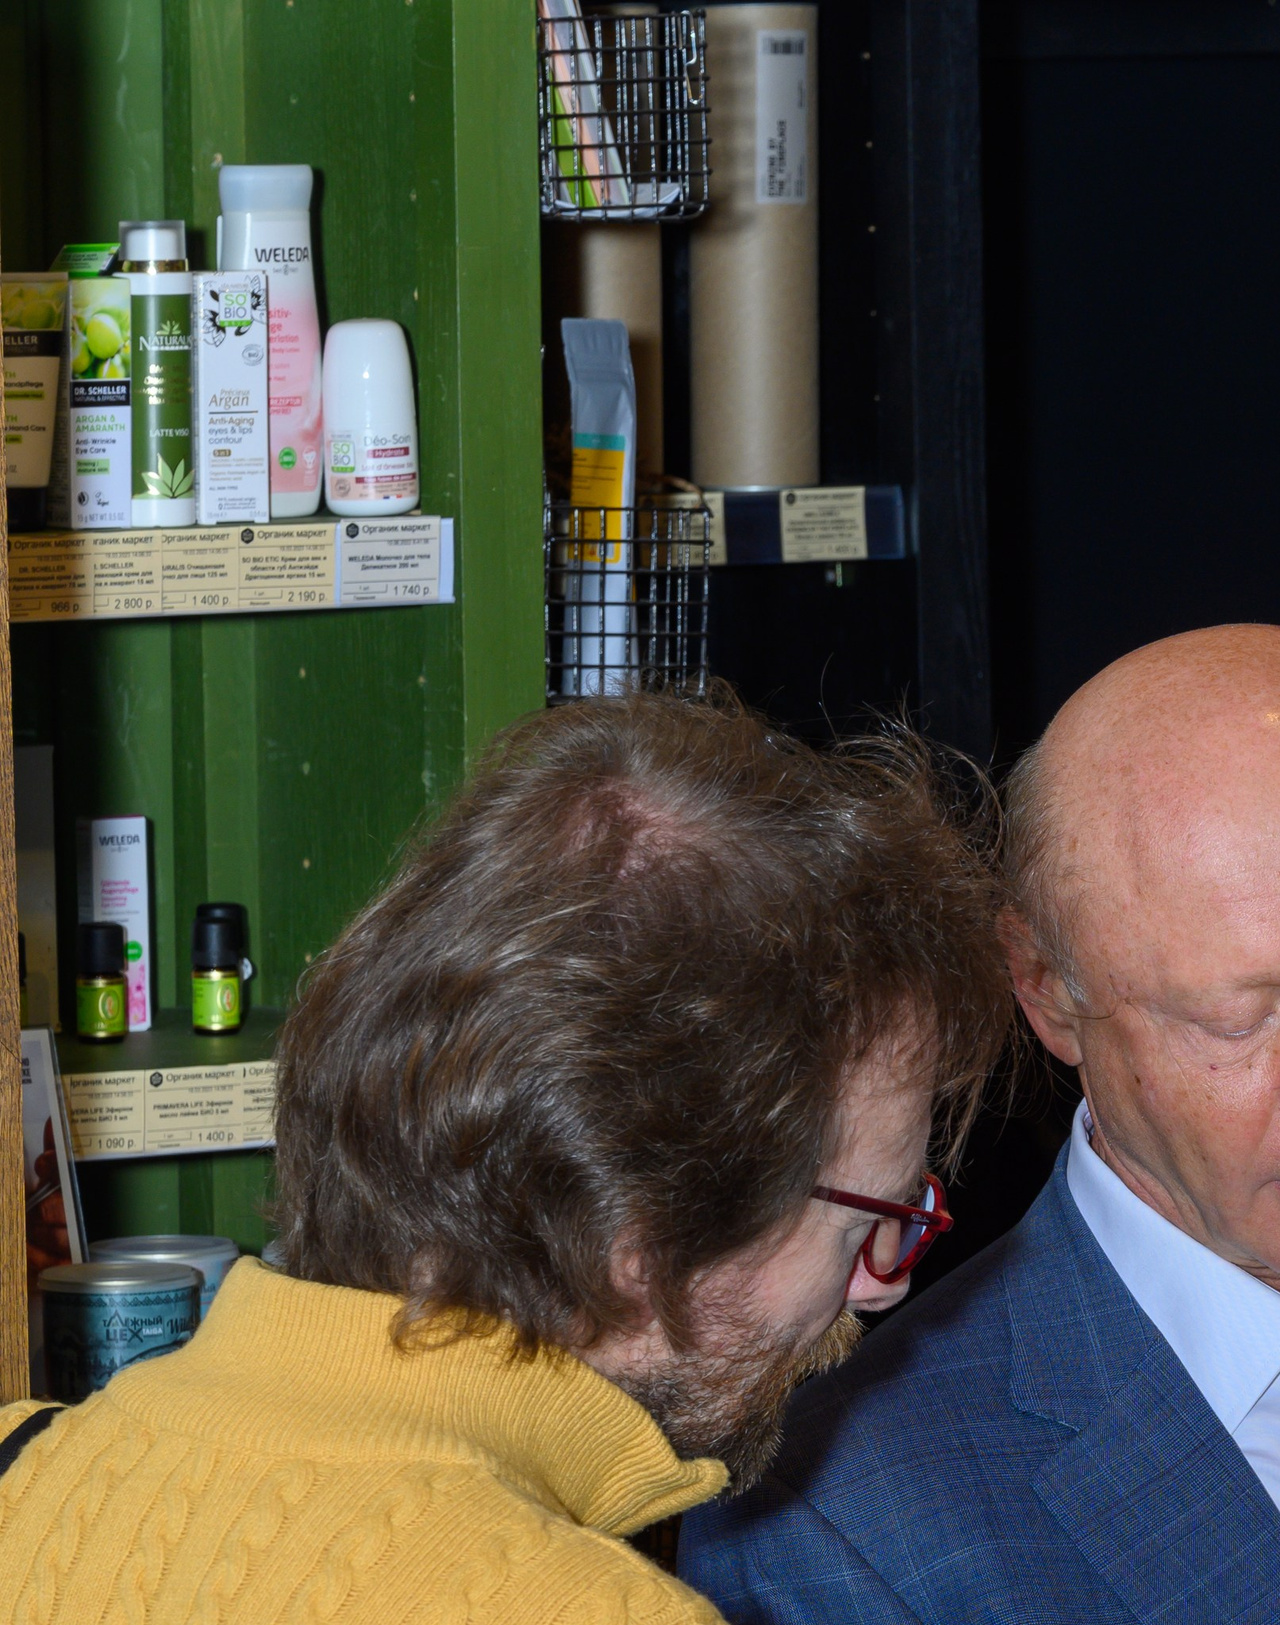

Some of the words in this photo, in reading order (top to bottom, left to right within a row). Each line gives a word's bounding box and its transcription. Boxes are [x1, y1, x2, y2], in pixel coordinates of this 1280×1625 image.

[255, 247, 310, 263] WELEDA
[87, 385, 127, 395] SCHELLER
[209, 393, 250, 410] Argan
[75, 414, 108, 423] ARGAN
[208, 416, 255, 427] Anti-Aging
[75, 423, 125, 433] AMARANTH
[150, 428, 174, 437] LATTE
[174, 428, 190, 437] VISO
[208, 427, 229, 436] eyes
[238, 425, 253, 437] lips
[208, 435, 243, 445] contour
[75, 447, 89, 455] Eye
[89, 446, 107, 454] Care
[257, 531, 295, 540] Органик
[296, 529, 327, 539] маркет
[362, 525, 399, 535] Органик
[401, 523, 431, 533] маркет
[122, 535, 154, 545] маркет
[199, 533, 230, 543] маркет
[100, 562, 134, 570] SCHELLER
[402, 584, 421, 596] 740
[200, 594, 222, 605] 400
[287, 591, 295, 602] 2
[299, 591, 317, 602] 190
[114, 598, 121, 609] 2
[121, 598, 143, 609] 800
[98, 834, 141, 847] WELEDA
[166, 1071, 200, 1083] Органик
[202, 1069, 236, 1080] маркет
[70, 1076, 103, 1088] рганик
[104, 1076, 136, 1086] маркет
[205, 1131, 226, 1142] 400
[106, 1137, 125, 1149] 090
